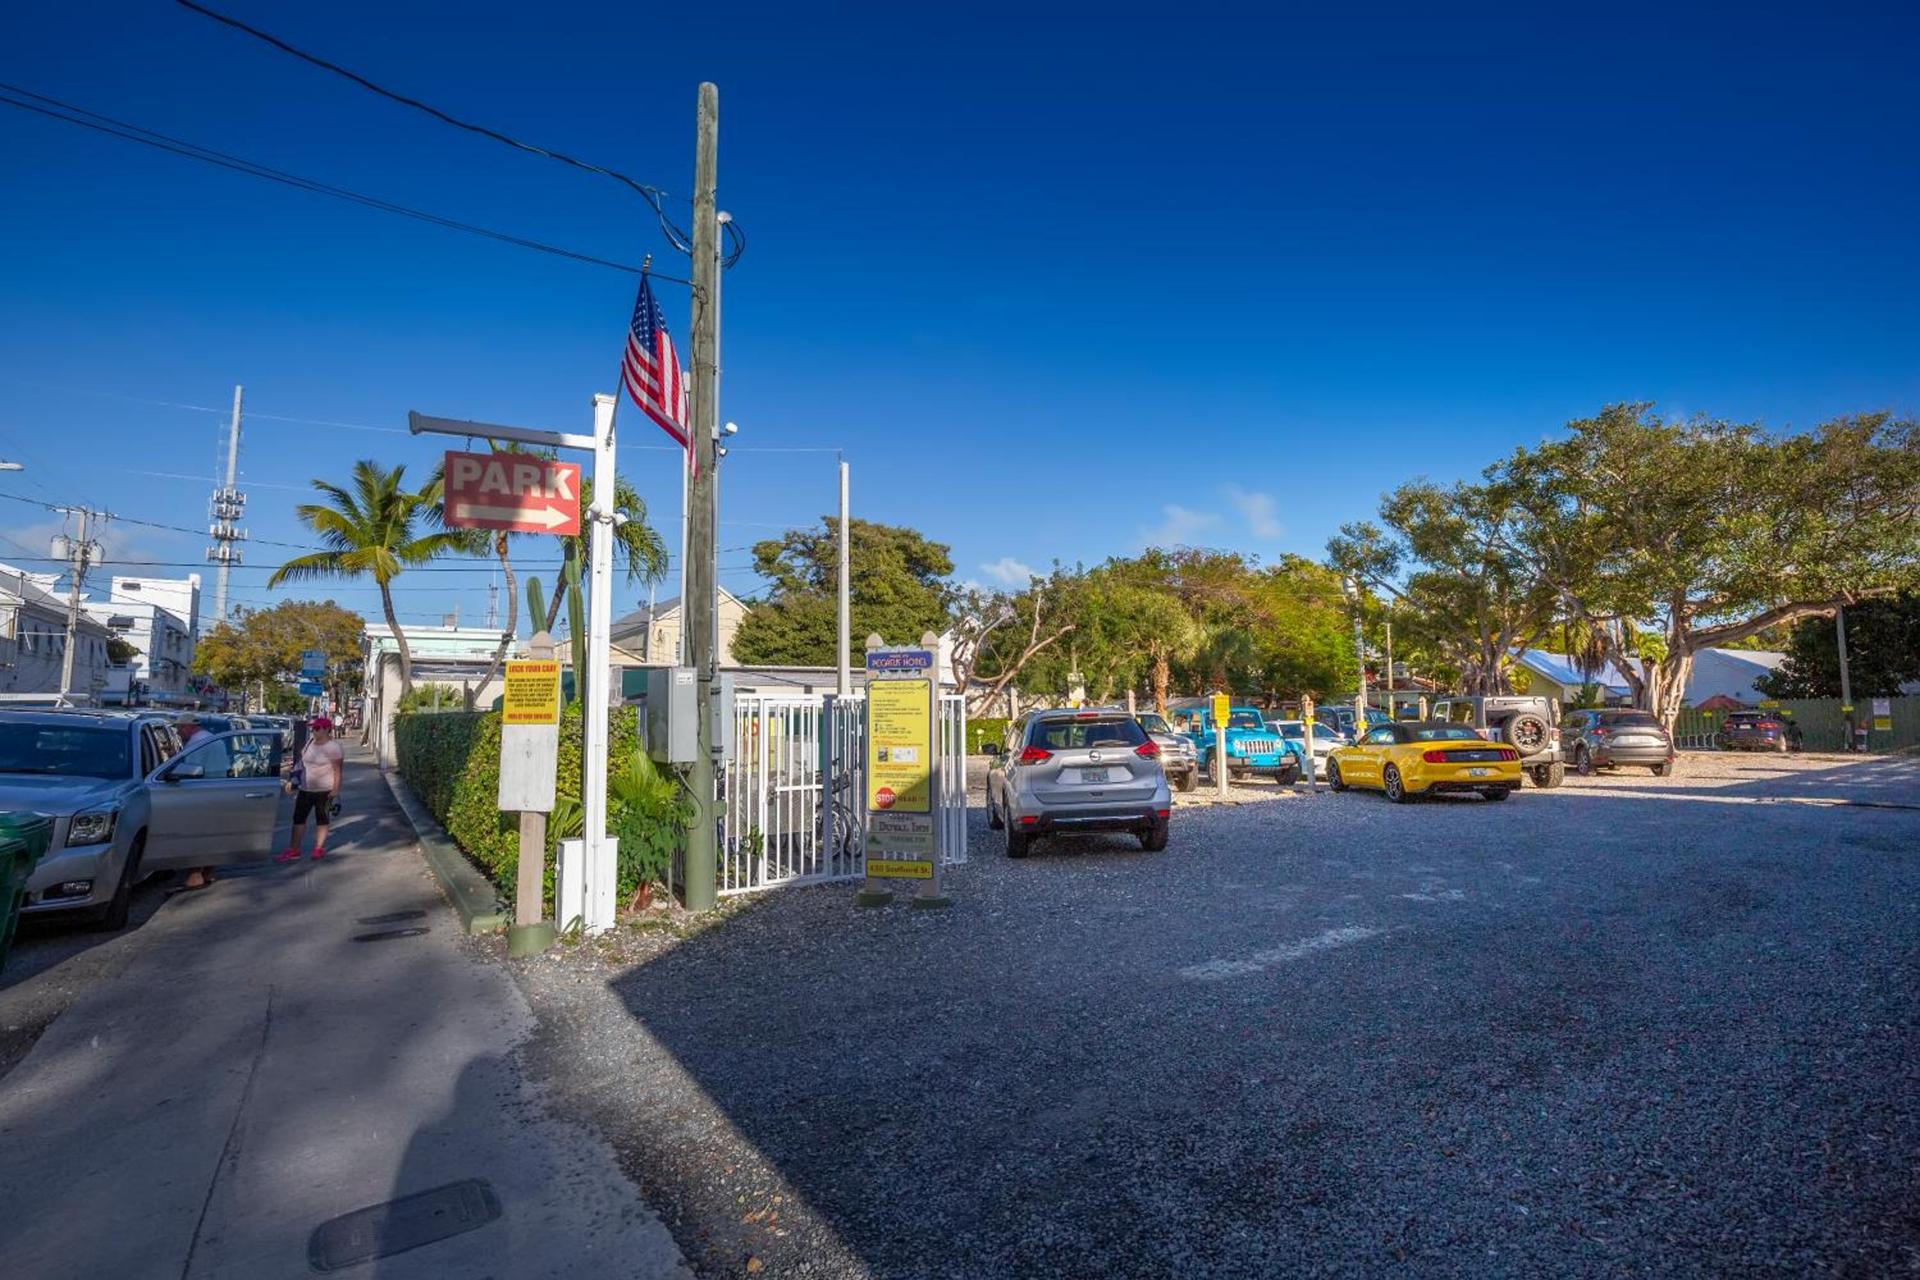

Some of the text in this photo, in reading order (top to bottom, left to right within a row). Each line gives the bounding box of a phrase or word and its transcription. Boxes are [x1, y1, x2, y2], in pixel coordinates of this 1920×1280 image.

[452, 457, 575, 501] PARK
[903, 657, 928, 667] HOTEL
[876, 794, 896, 803] STOP
[879, 821, 909, 832] DUVAL
